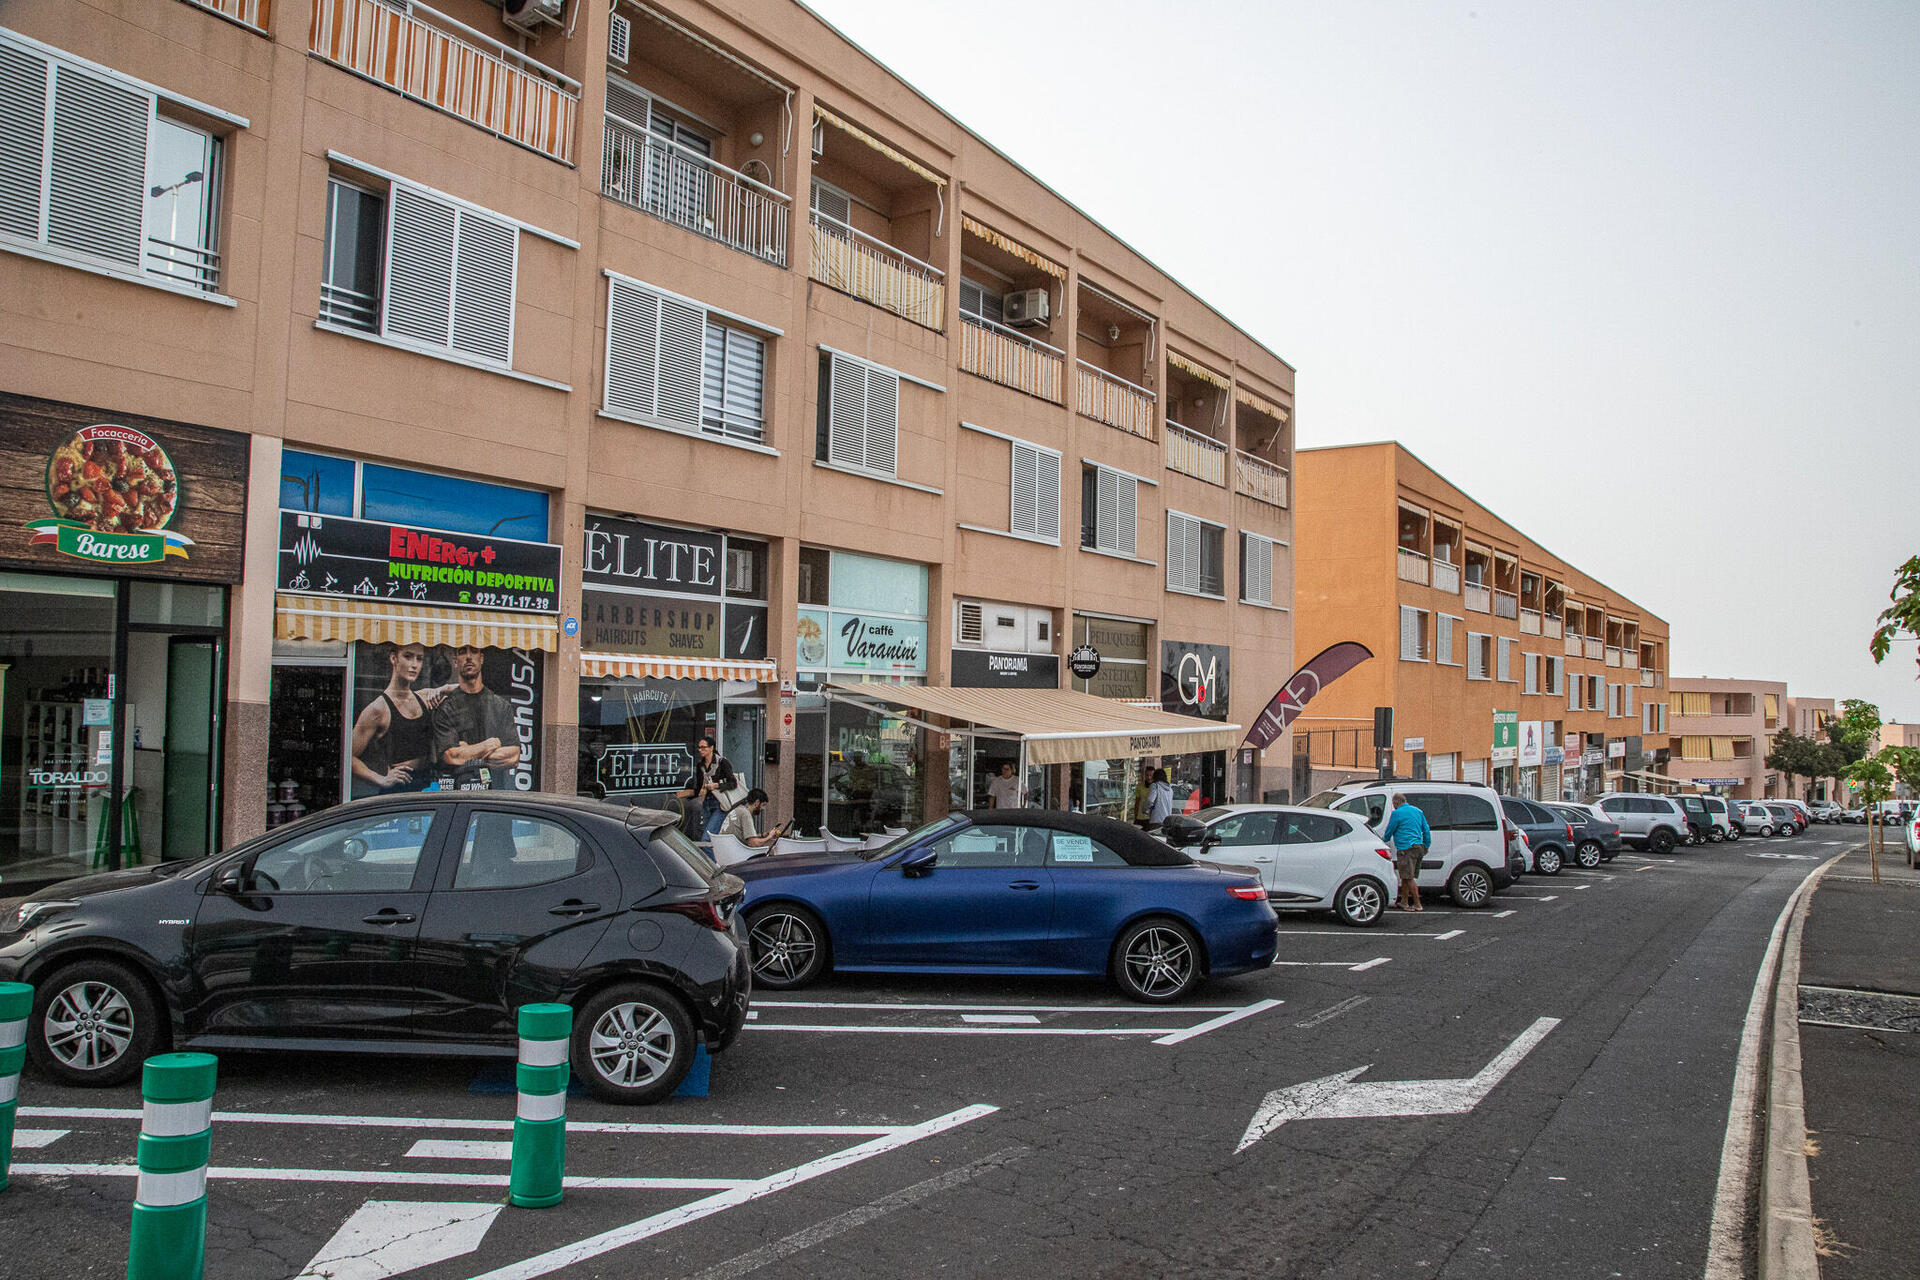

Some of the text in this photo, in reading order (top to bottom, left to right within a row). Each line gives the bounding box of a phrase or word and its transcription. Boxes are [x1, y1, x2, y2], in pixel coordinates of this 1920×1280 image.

[91, 428, 148, 446] Focacceria
[77, 533, 150, 559] Barese
[583, 522, 716, 586] ÉLITE
[389, 562, 555, 593] NUTRICIÓN DEPORTIVA
[476, 592, 549, 610] 922-71-17-38
[582, 603, 714, 631] BARBERSHOP
[596, 628, 704, 649] HAIRCUTS SHAVES
[841, 617, 918, 661] Varanini
[632, 689, 668, 704] HAIRCUTS
[609, 750, 681, 777] ÉLITE
[28, 770, 108, 784] TORALDO
[615, 775, 677, 788] BARBERSHOP
